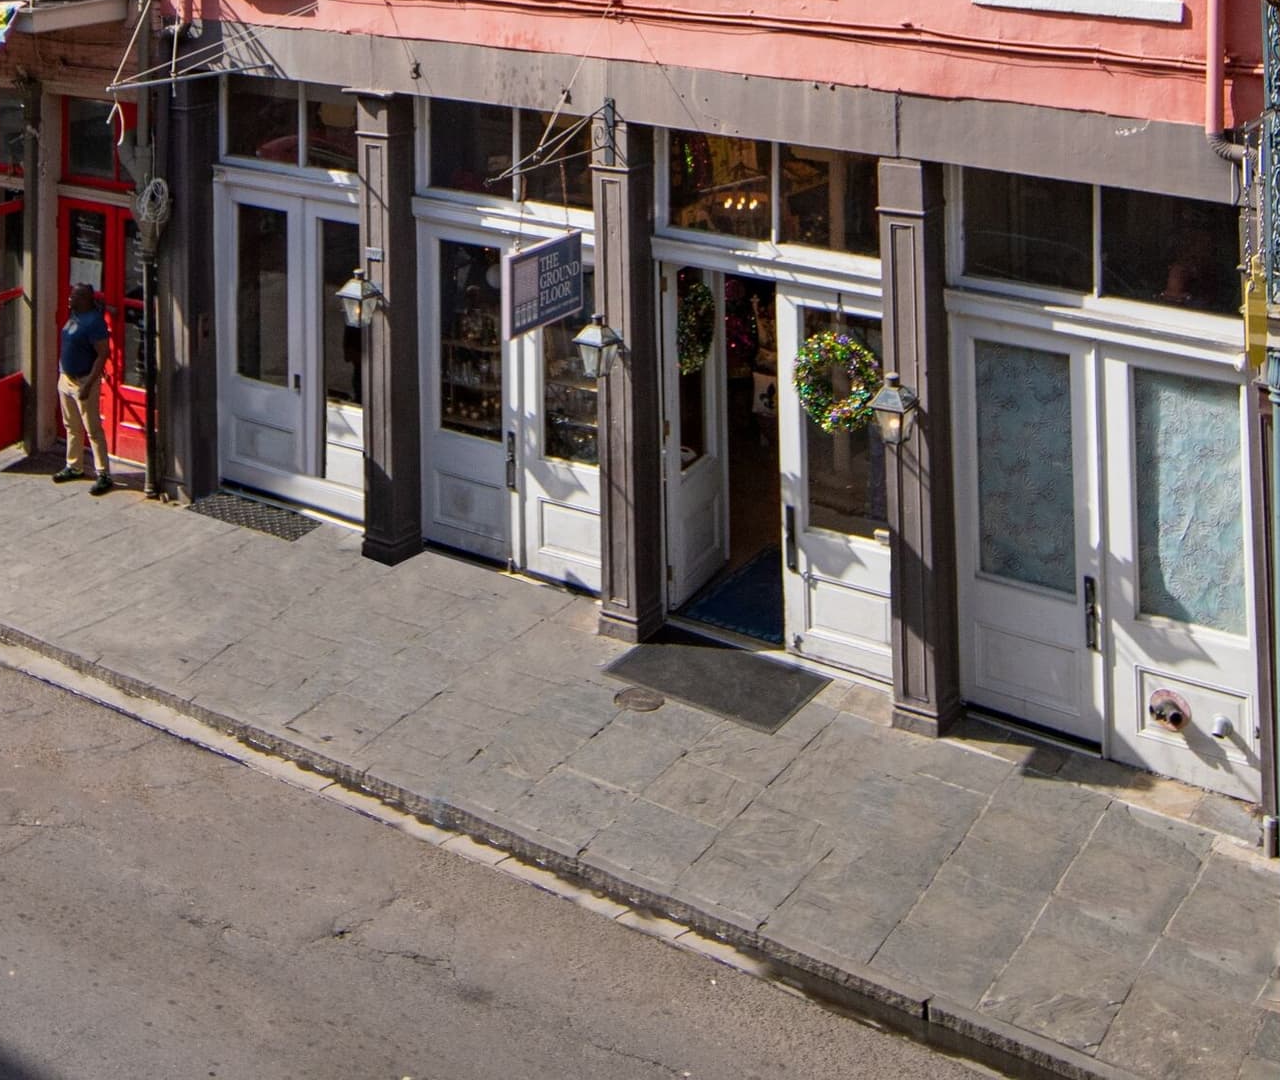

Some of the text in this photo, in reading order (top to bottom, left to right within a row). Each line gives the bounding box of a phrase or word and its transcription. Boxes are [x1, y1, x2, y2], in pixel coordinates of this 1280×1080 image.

[540, 251, 560, 273] THE
[540, 260, 580, 290] GROUND
[540, 281, 572, 307] FLOOR
